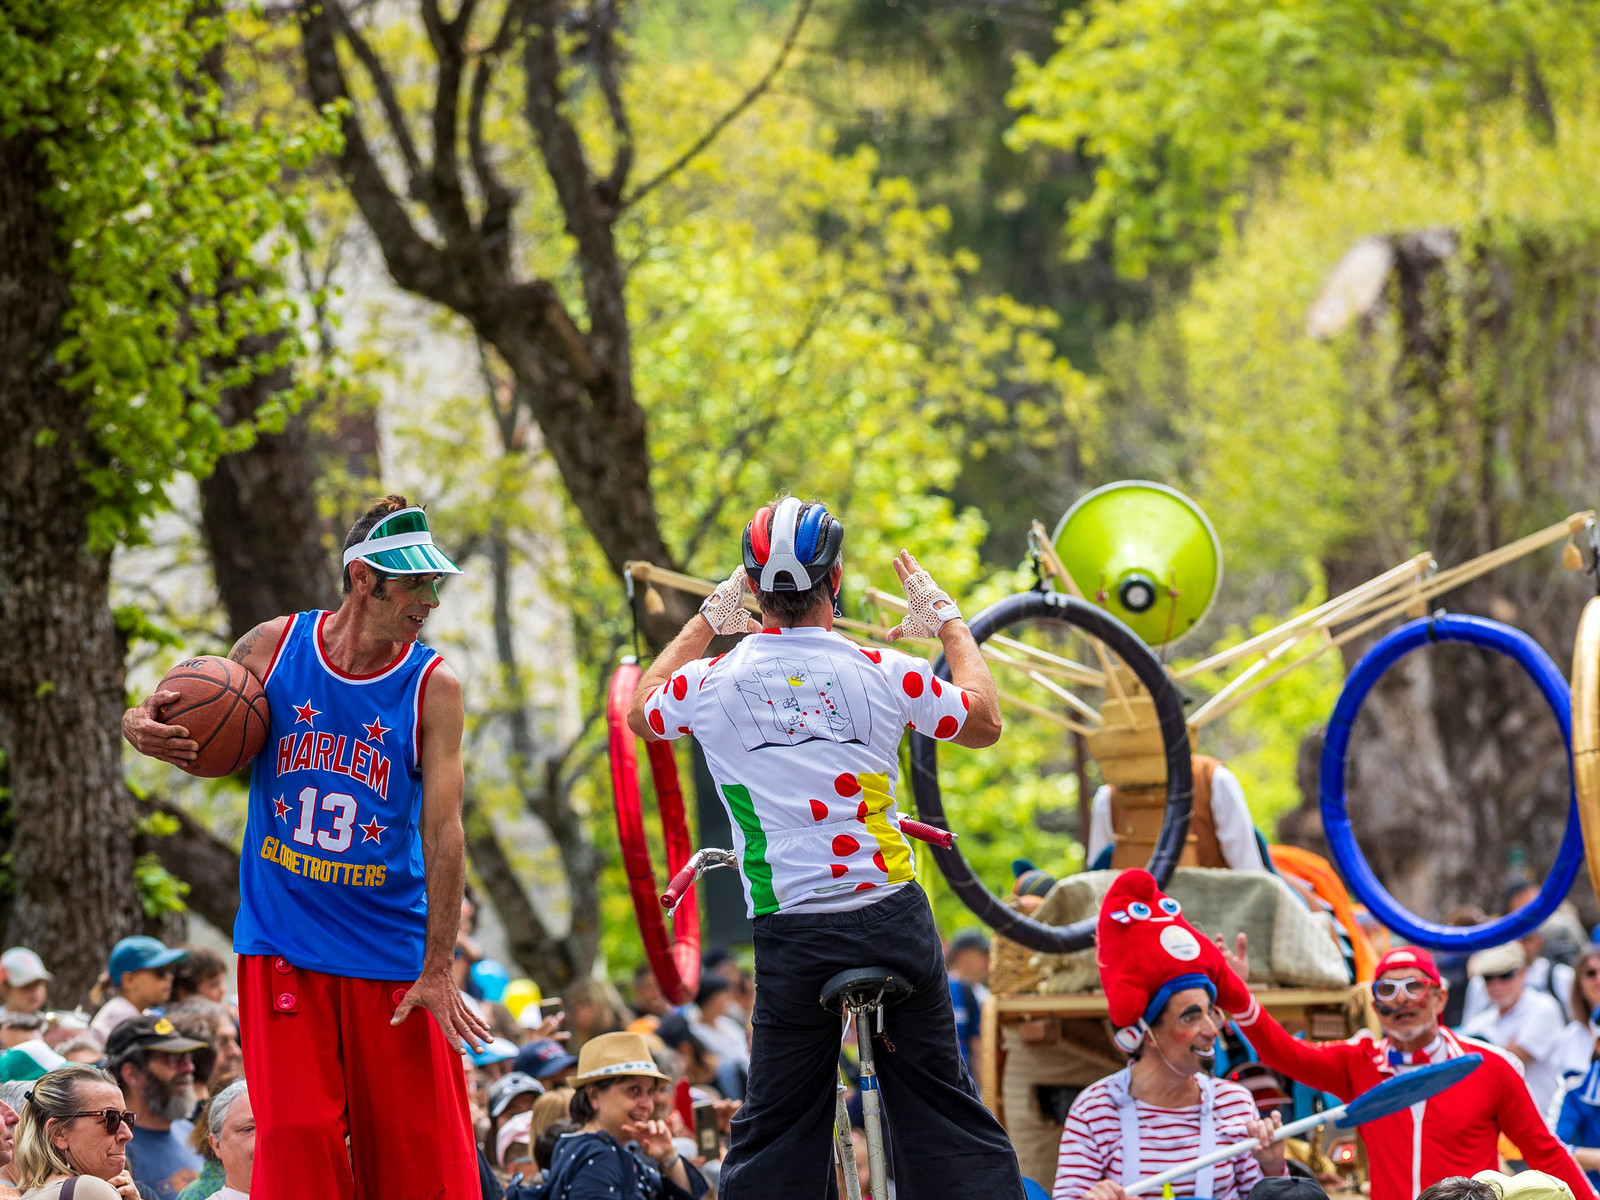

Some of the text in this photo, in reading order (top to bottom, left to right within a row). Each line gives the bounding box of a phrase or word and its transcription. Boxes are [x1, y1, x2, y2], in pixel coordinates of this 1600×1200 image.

[277, 731, 391, 801] HARLEM
[292, 786, 359, 853] 13
[260, 835, 388, 887] GLOBETROTTERS
